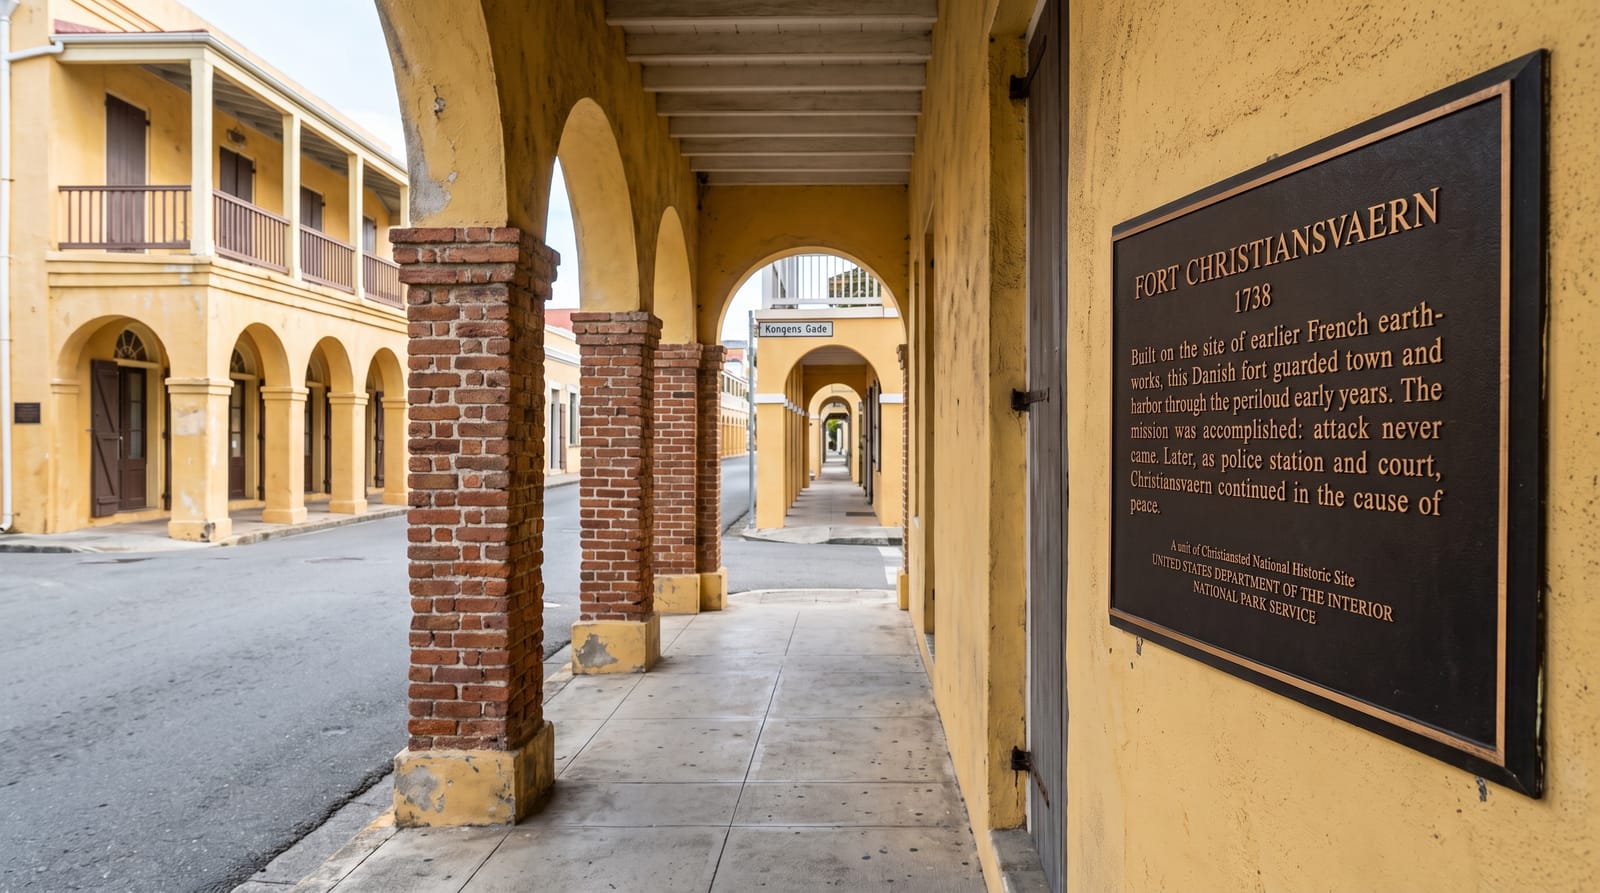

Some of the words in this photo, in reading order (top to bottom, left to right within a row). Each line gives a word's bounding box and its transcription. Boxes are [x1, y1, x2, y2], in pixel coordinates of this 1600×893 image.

[1135, 264, 1179, 300] FORT
[1186, 187, 1440, 285] CHRISTIANSVAERN
[1234, 282, 1272, 313] 1738
[765, 325, 801, 335] Kongens
[805, 324, 827, 334] Gade
[1131, 346, 1156, 366] Built
[1160, 349, 1174, 361] on
[1179, 342, 1198, 360] the
[1203, 336, 1225, 358] site
[1231, 331, 1247, 352] of
[1251, 325, 1300, 350] earlier
[1307, 312, 1368, 343] French
[1378, 301, 1444, 332] earth-
[1131, 372, 1163, 391] works,
[1168, 369, 1188, 387] this
[1192, 362, 1236, 385] Danish
[1241, 358, 1267, 381] fort
[1273, 351, 1338, 383] guarded
[1346, 347, 1392, 369] town
[1403, 337, 1443, 366] and
[1131, 397, 1162, 415] harbor
[1165, 394, 1207, 416] through
[1210, 392, 1230, 412] the
[1233, 387, 1290, 415] periloud
[1294, 385, 1334, 412] early
[1339, 384, 1393, 411] years.
[1401, 377, 1442, 402] The
[1131, 424, 1168, 439] mission
[1175, 424, 1196, 439] was
[1203, 417, 1303, 444] accomplished:
[1314, 415, 1369, 440] attack
[1382, 420, 1442, 440] never
[1131, 448, 1159, 465] came.
[1163, 447, 1197, 468] Later,
[1202, 453, 1215, 467] as
[1221, 449, 1262, 473] police
[1269, 450, 1324, 472] station
[1334, 451, 1367, 475] and
[1378, 453, 1443, 482] court,
[1131, 470, 1212, 494] Christiansvaern
[1218, 480, 1286, 502] continued
[1294, 480, 1309, 503] in
[1318, 484, 1345, 507] the
[1354, 492, 1408, 512] cause
[1419, 489, 1444, 516] of
[1131, 497, 1161, 515] peace.
[1171, 540, 1177, 551] A
[1178, 541, 1191, 555] unit
[1193, 543, 1201, 556] of
[1201, 545, 1251, 566] Christiansted
[1253, 555, 1290, 574] National
[1293, 562, 1332, 583] Historic
[1334, 570, 1356, 588] Site
[1152, 553, 1181, 570] UNITED
[1183, 561, 1212, 578] STATES
[1215, 568, 1281, 594] DEPARTMENT
[1282, 583, 1297, 598] OF
[1300, 587, 1325, 605] THE
[1328, 593, 1393, 622] INTERIOR
[1193, 581, 1238, 604] NATIONAL
[1241, 592, 1266, 611] PARK
[1269, 600, 1317, 624] SERVICE
